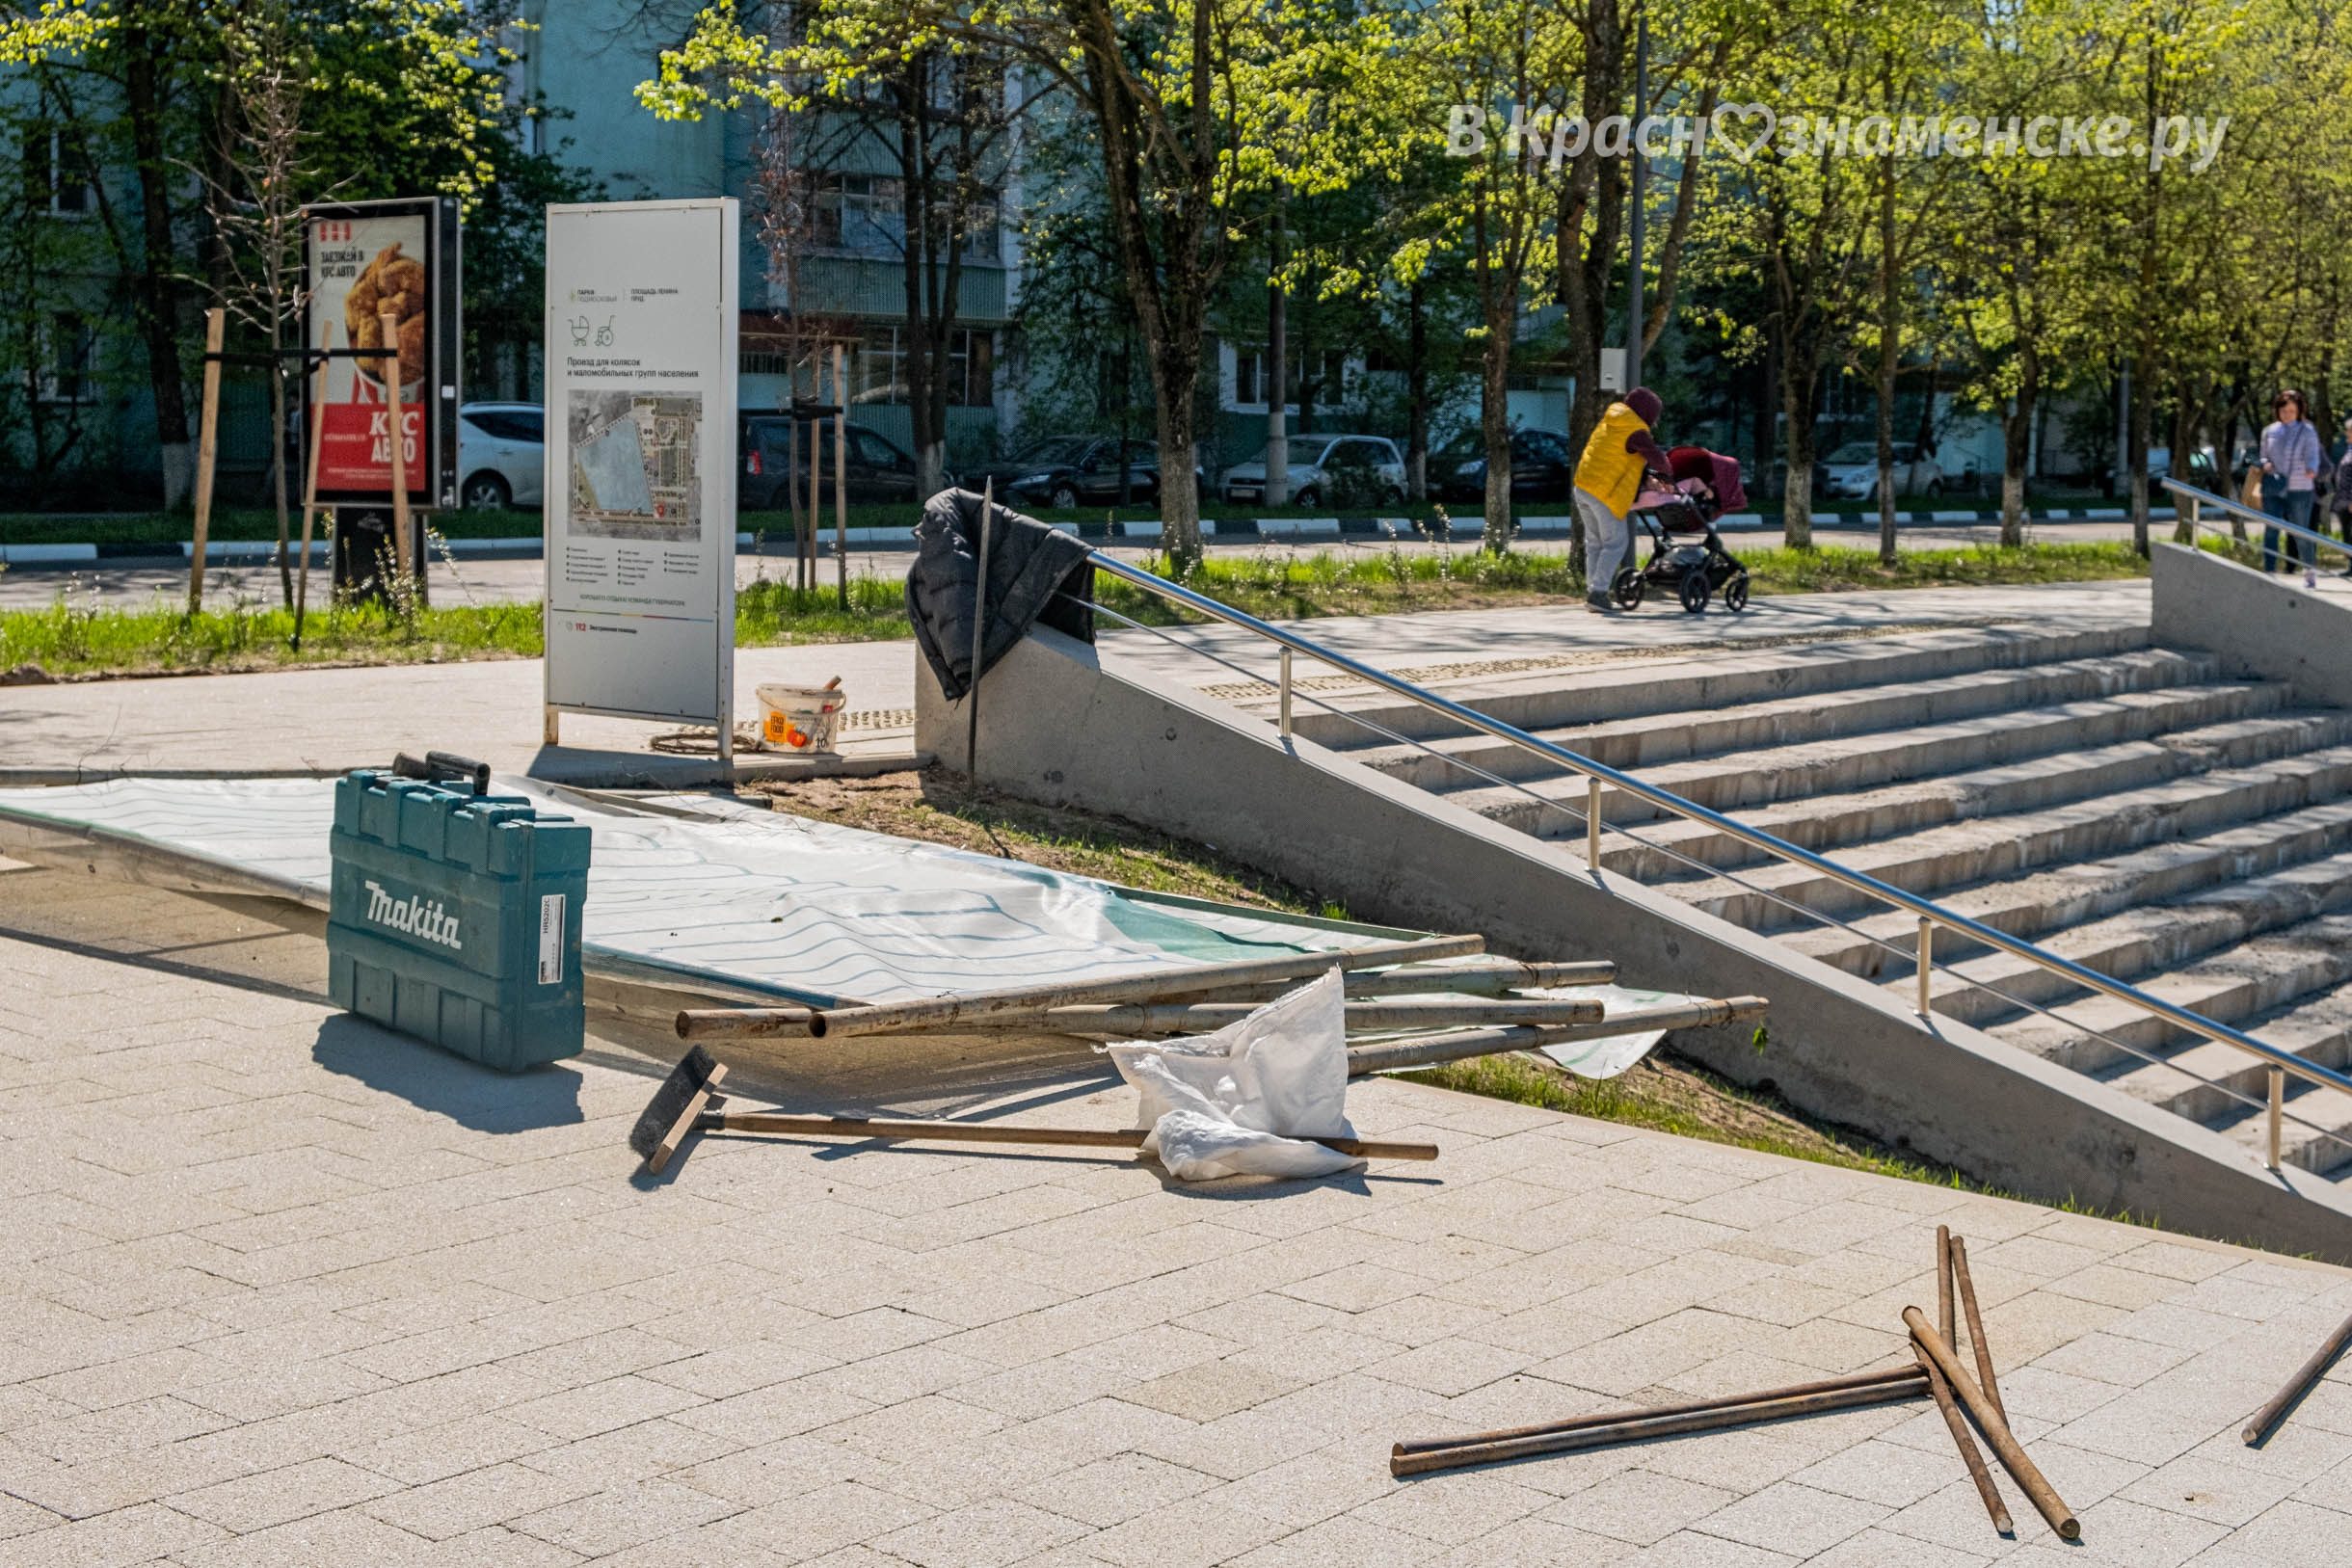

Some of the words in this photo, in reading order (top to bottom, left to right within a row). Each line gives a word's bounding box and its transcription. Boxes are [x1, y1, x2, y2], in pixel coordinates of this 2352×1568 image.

[567, 357, 595, 367] Проезд
[574, 367, 633, 377] маломобильных
[634, 369, 656, 378] групп
[658, 369, 699, 378] населения
[369, 411, 420, 436] KC
[371, 437, 416, 463] АВО
